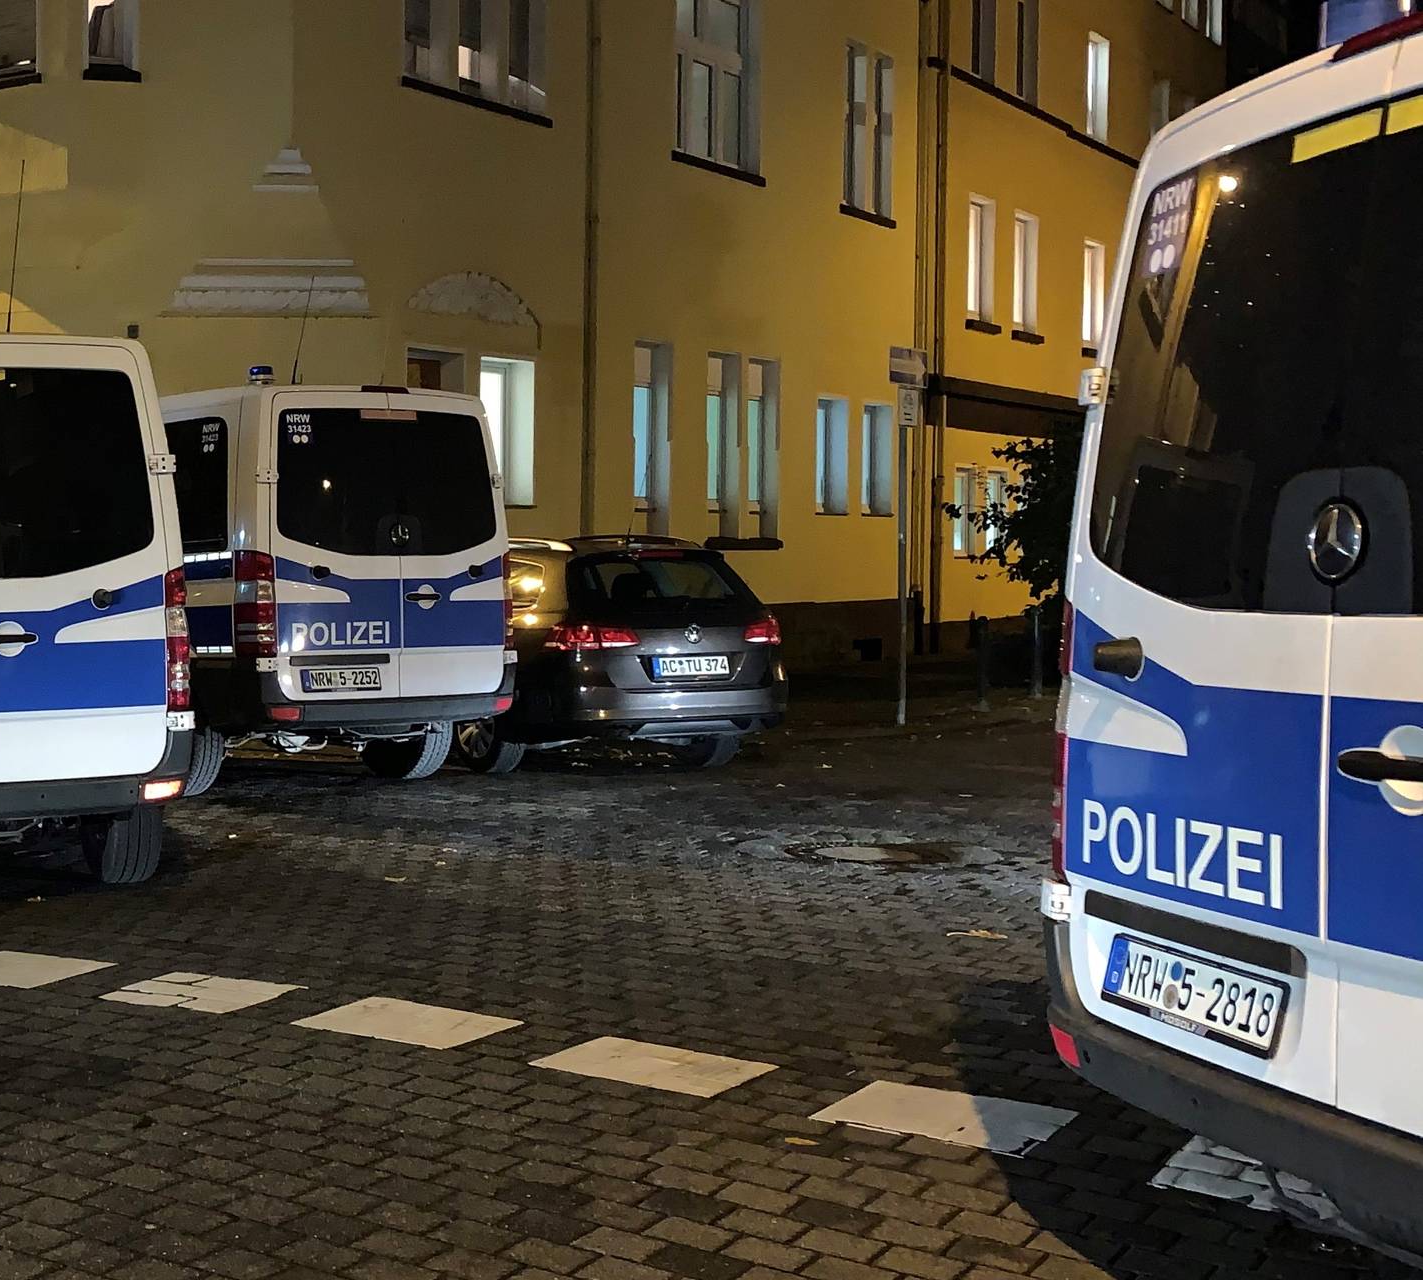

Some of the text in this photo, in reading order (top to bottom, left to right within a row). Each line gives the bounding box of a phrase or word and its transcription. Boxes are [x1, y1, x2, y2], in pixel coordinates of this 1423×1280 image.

[1152, 178, 1194, 217] NRW
[1148, 209, 1188, 245] 31411
[286, 413, 311, 423] NRW
[287, 424, 312, 433] 31423
[292, 621, 390, 648] POLIZEI
[310, 670, 379, 687] NRW 5-2252
[662, 658, 727, 673] AC TU 374
[1082, 798, 1283, 910] POLIZEI
[1122, 949, 1275, 1038] NRW 5-2818
